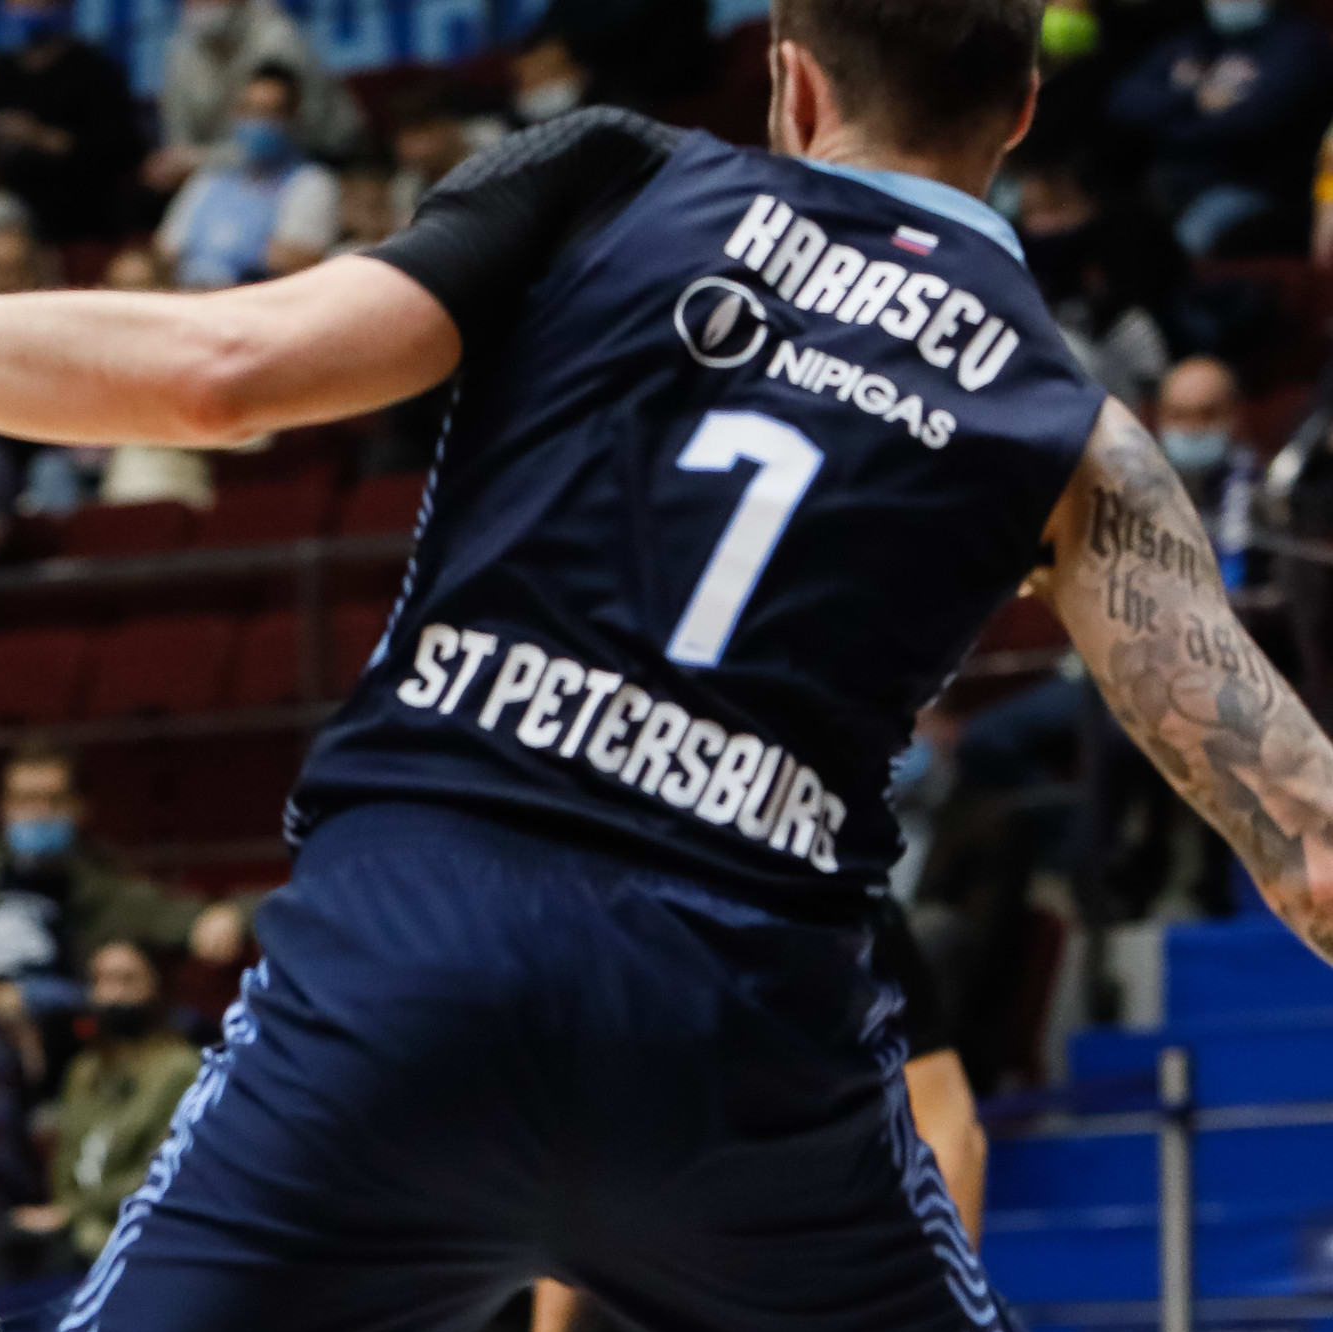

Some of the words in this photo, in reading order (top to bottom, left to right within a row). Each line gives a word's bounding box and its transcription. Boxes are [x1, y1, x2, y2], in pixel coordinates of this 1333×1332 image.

[724, 193, 1020, 392] KARASEV
[765, 339, 958, 450] NIPIGAS
[665, 409, 826, 668] 7
[397, 622, 498, 716] ST
